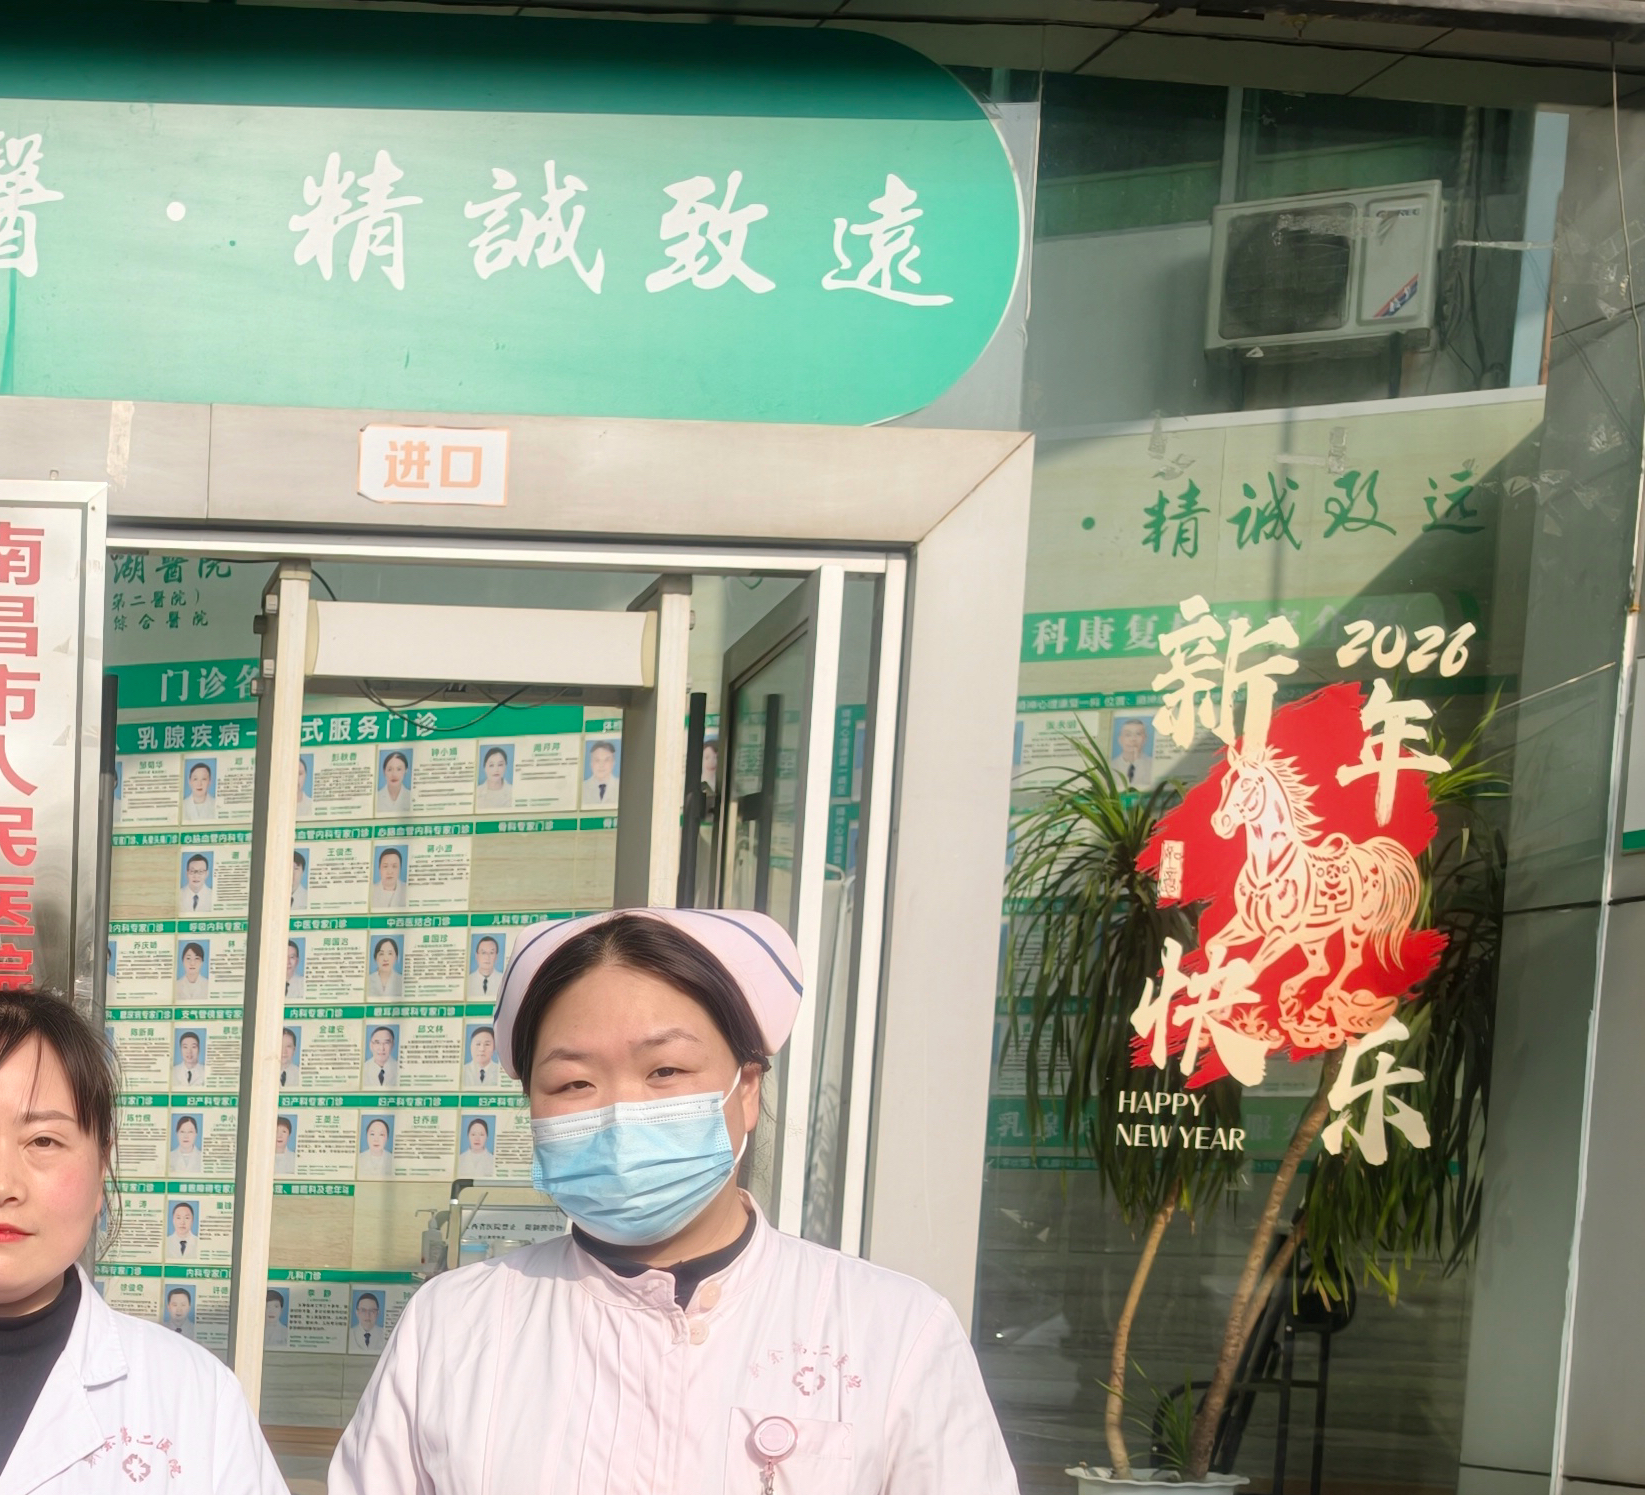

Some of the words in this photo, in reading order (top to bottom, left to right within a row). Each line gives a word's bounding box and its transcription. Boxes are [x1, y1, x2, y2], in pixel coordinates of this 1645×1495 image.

[384, 440, 484, 491] 进口
[1336, 619, 1476, 677] 2026
[1118, 1090, 1206, 1117] HAPPY
[1116, 1124, 1172, 1148] NEW
[1179, 1126, 1246, 1152] YEAR
[287, 1270, 322, 1281] 儿科门诊
